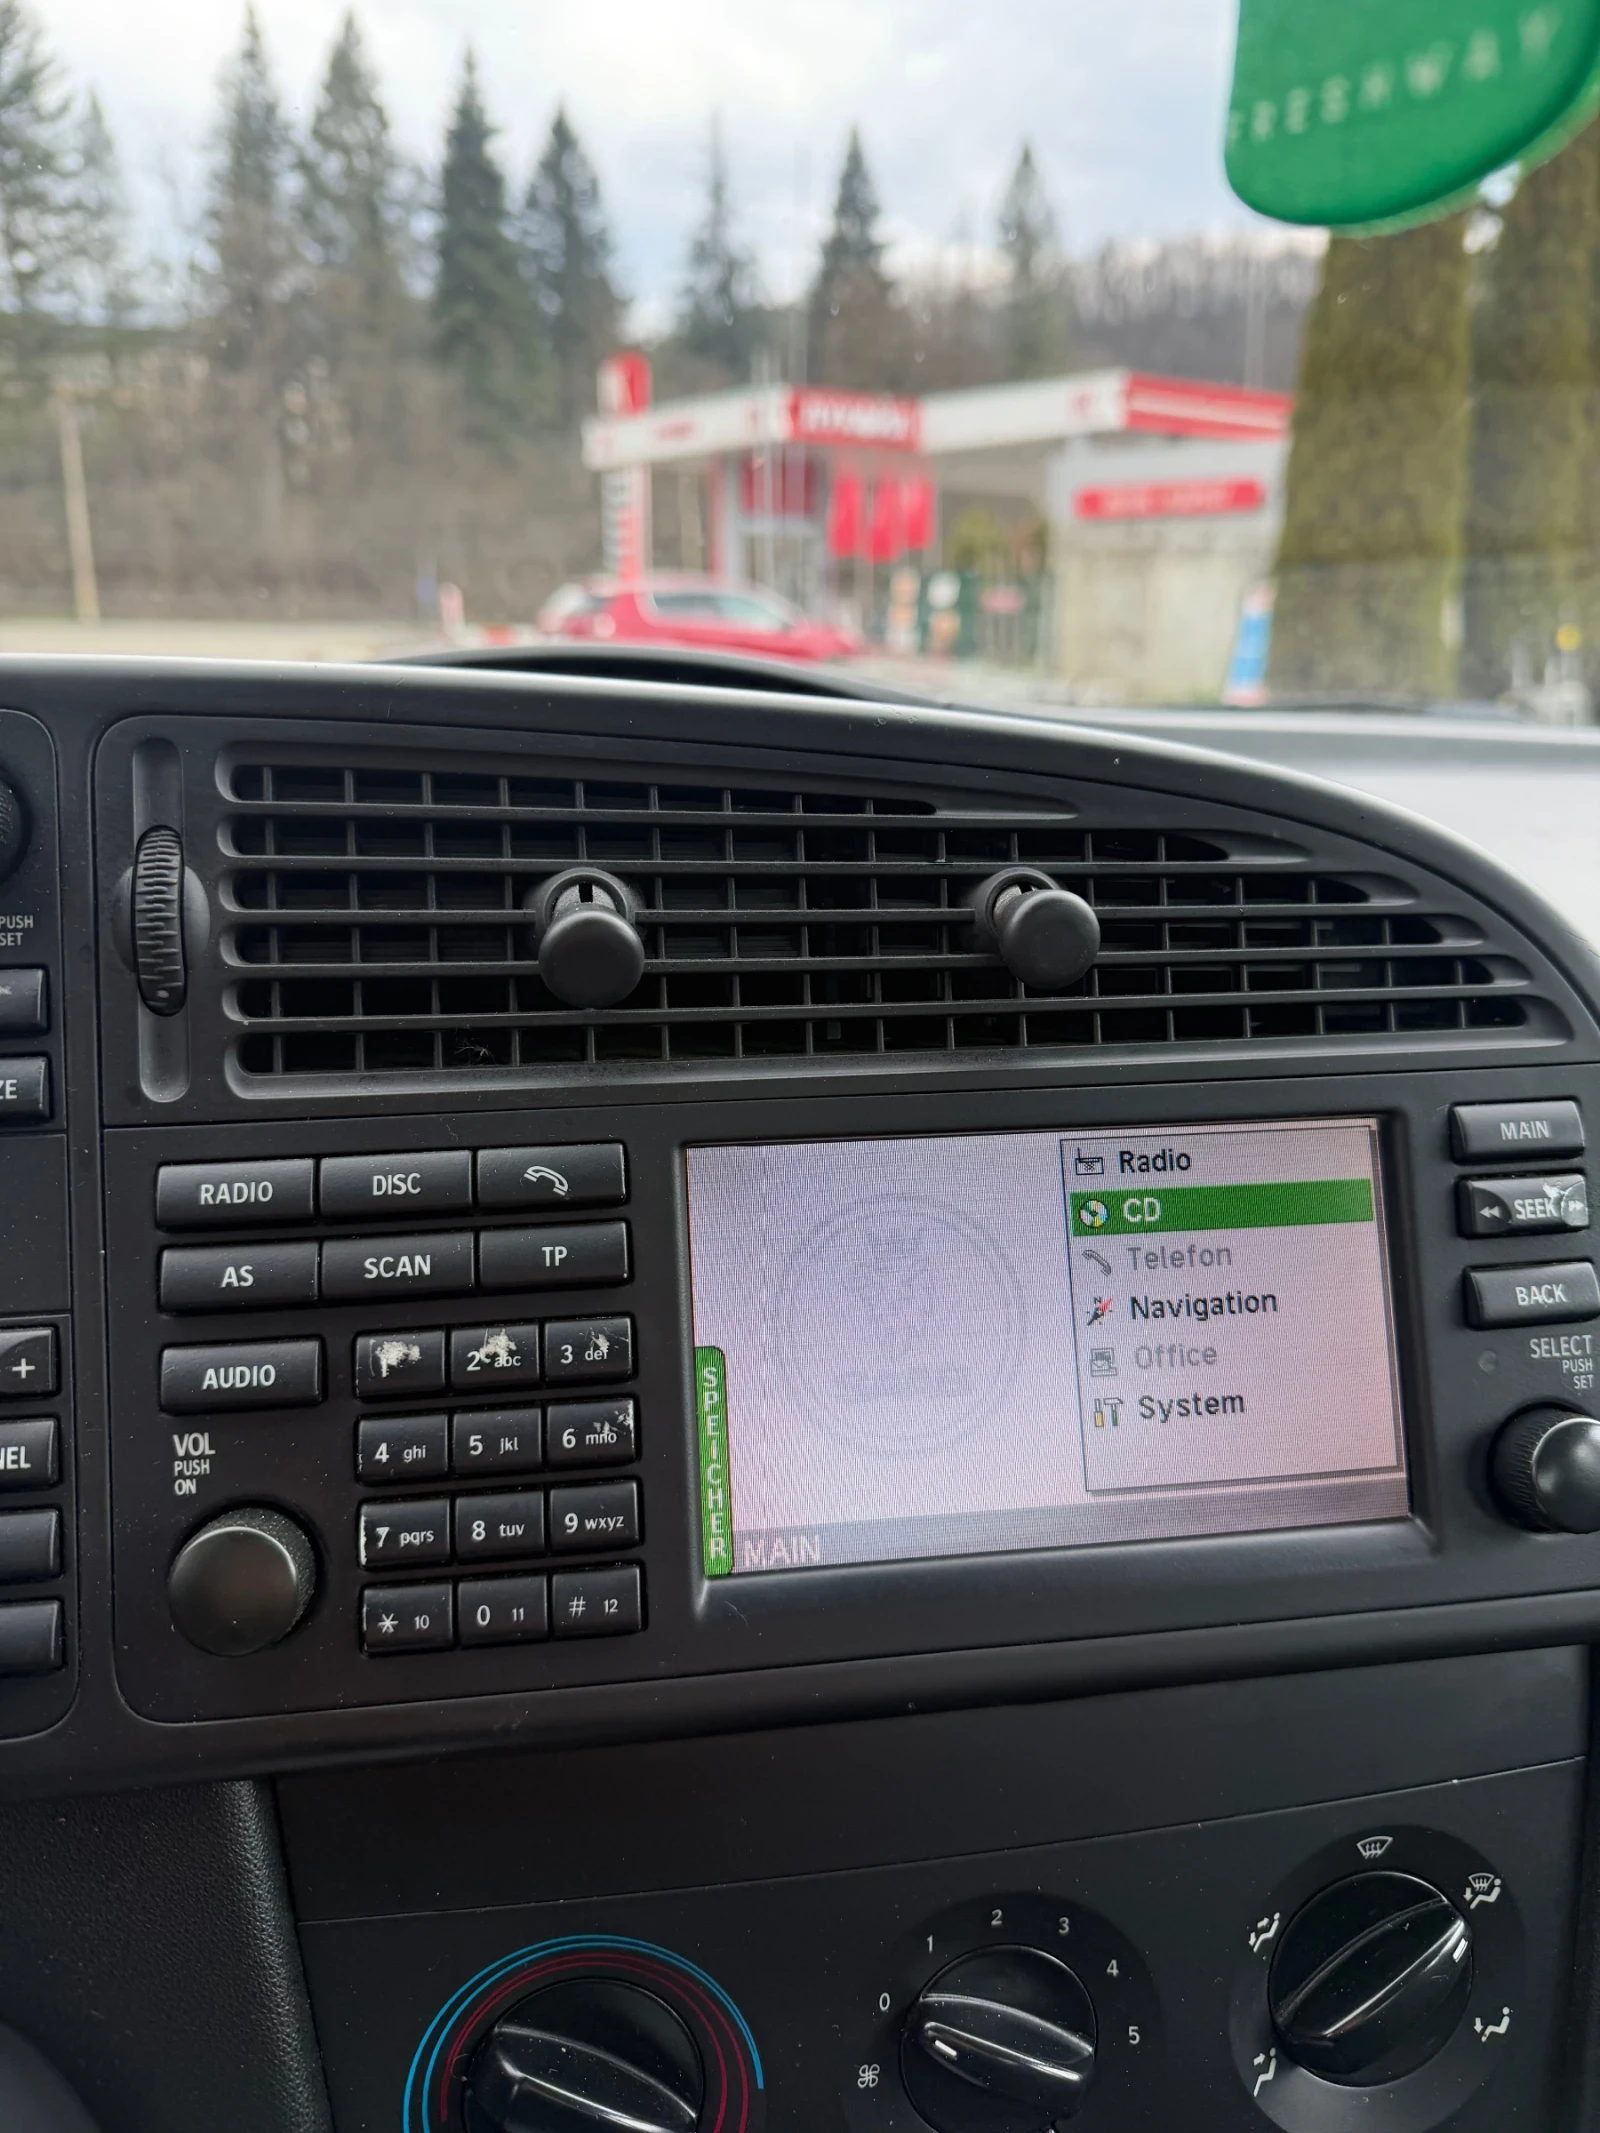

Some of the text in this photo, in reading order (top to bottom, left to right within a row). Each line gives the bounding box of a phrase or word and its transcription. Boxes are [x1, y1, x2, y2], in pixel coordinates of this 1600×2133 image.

[1500, 1120, 1550, 1141] MAIN
[1118, 1148, 1192, 1174] Radio
[200, 1181, 274, 1205] RADIO
[372, 1173, 422, 1196] DISC
[1122, 1197, 1162, 1222] CD
[1513, 1198, 1558, 1220] SEEK
[364, 1255, 432, 1279] SCAN
[541, 1246, 569, 1269] TP
[1127, 1244, 1232, 1271] Telefon
[221, 1265, 254, 1289] AS
[1515, 1283, 1567, 1306] BACK
[1130, 1290, 1278, 1321] Navigation
[560, 1344, 609, 1364] 3 def
[1135, 1343, 1217, 1370] Office
[1530, 1335, 1593, 1359] SELECT
[466, 1350, 521, 1371] 2 abc
[1562, 1359, 1593, 1374] PUSH
[202, 1364, 277, 1390] AUDIO
[1573, 1375, 1594, 1389] SET
[1138, 1392, 1245, 1423] System
[173, 1432, 216, 1457] VOL
[469, 1435, 518, 1455] 5 jkl
[562, 1428, 617, 1448] 6 mno
[375, 1442, 426, 1463] 4 ghi
[174, 1459, 211, 1477] PUSH
[703, 1367, 727, 1560] SPEICHER
[175, 1478, 197, 1496] ON
[472, 1520, 525, 1541] 8 tuv
[564, 1512, 625, 1533] 9 wxyz
[375, 1526, 434, 1548] 7 pqrs
[743, 1534, 821, 1567] MAIN
[476, 1605, 525, 1626] 0 11
[603, 1599, 619, 1613] 12
[414, 1615, 430, 1630] 10
[990, 1909, 1003, 1926] 2
[1058, 1917, 1070, 1935] 3
[926, 1935, 933, 1952] 1
[1106, 1959, 1119, 1977] 4
[879, 1992, 891, 2011] 0
[1128, 2026, 1141, 2044] 5
